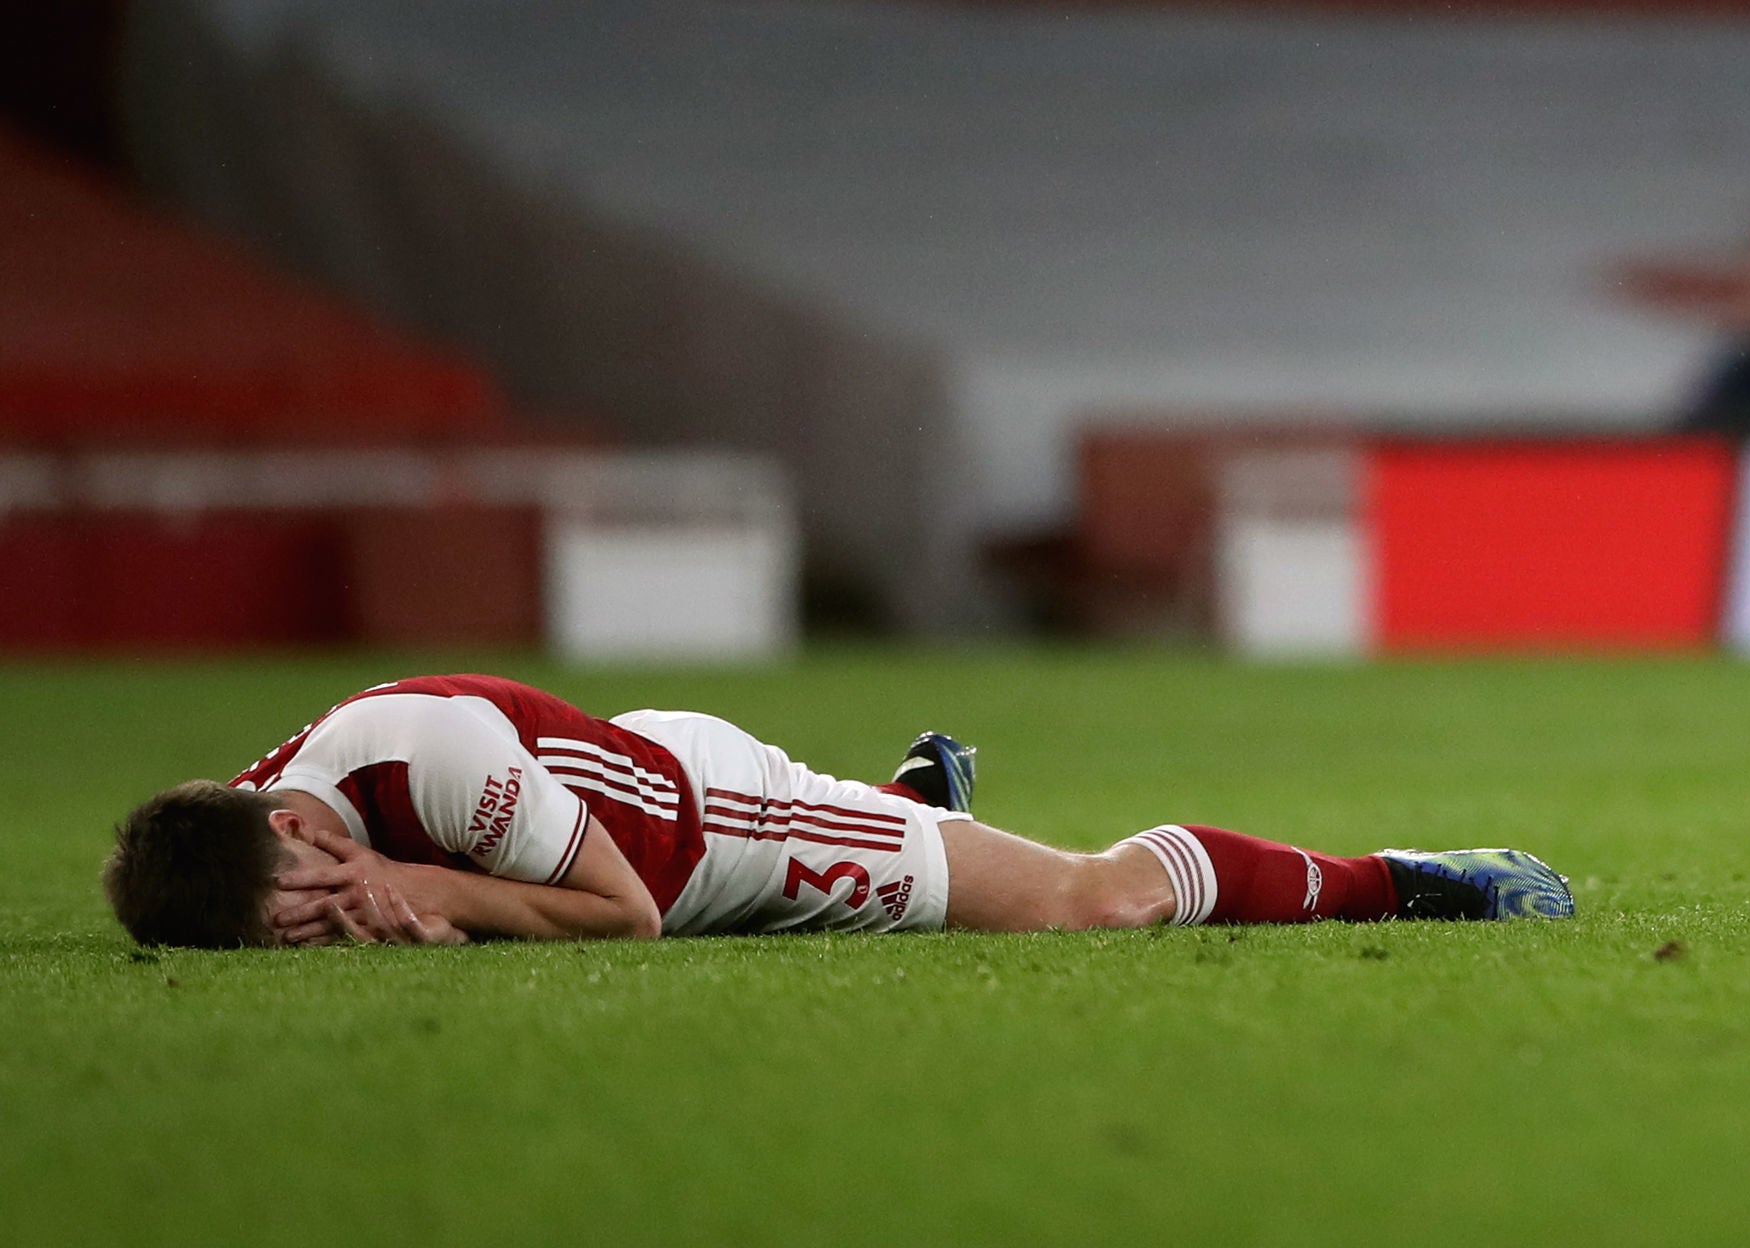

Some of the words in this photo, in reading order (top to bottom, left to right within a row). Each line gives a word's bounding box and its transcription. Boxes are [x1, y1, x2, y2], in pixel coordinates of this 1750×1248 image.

[468, 775, 503, 832] VISIT
[471, 766, 523, 857] RWANDA
[782, 856, 870, 910] 3
[892, 874, 914, 921] adidas
